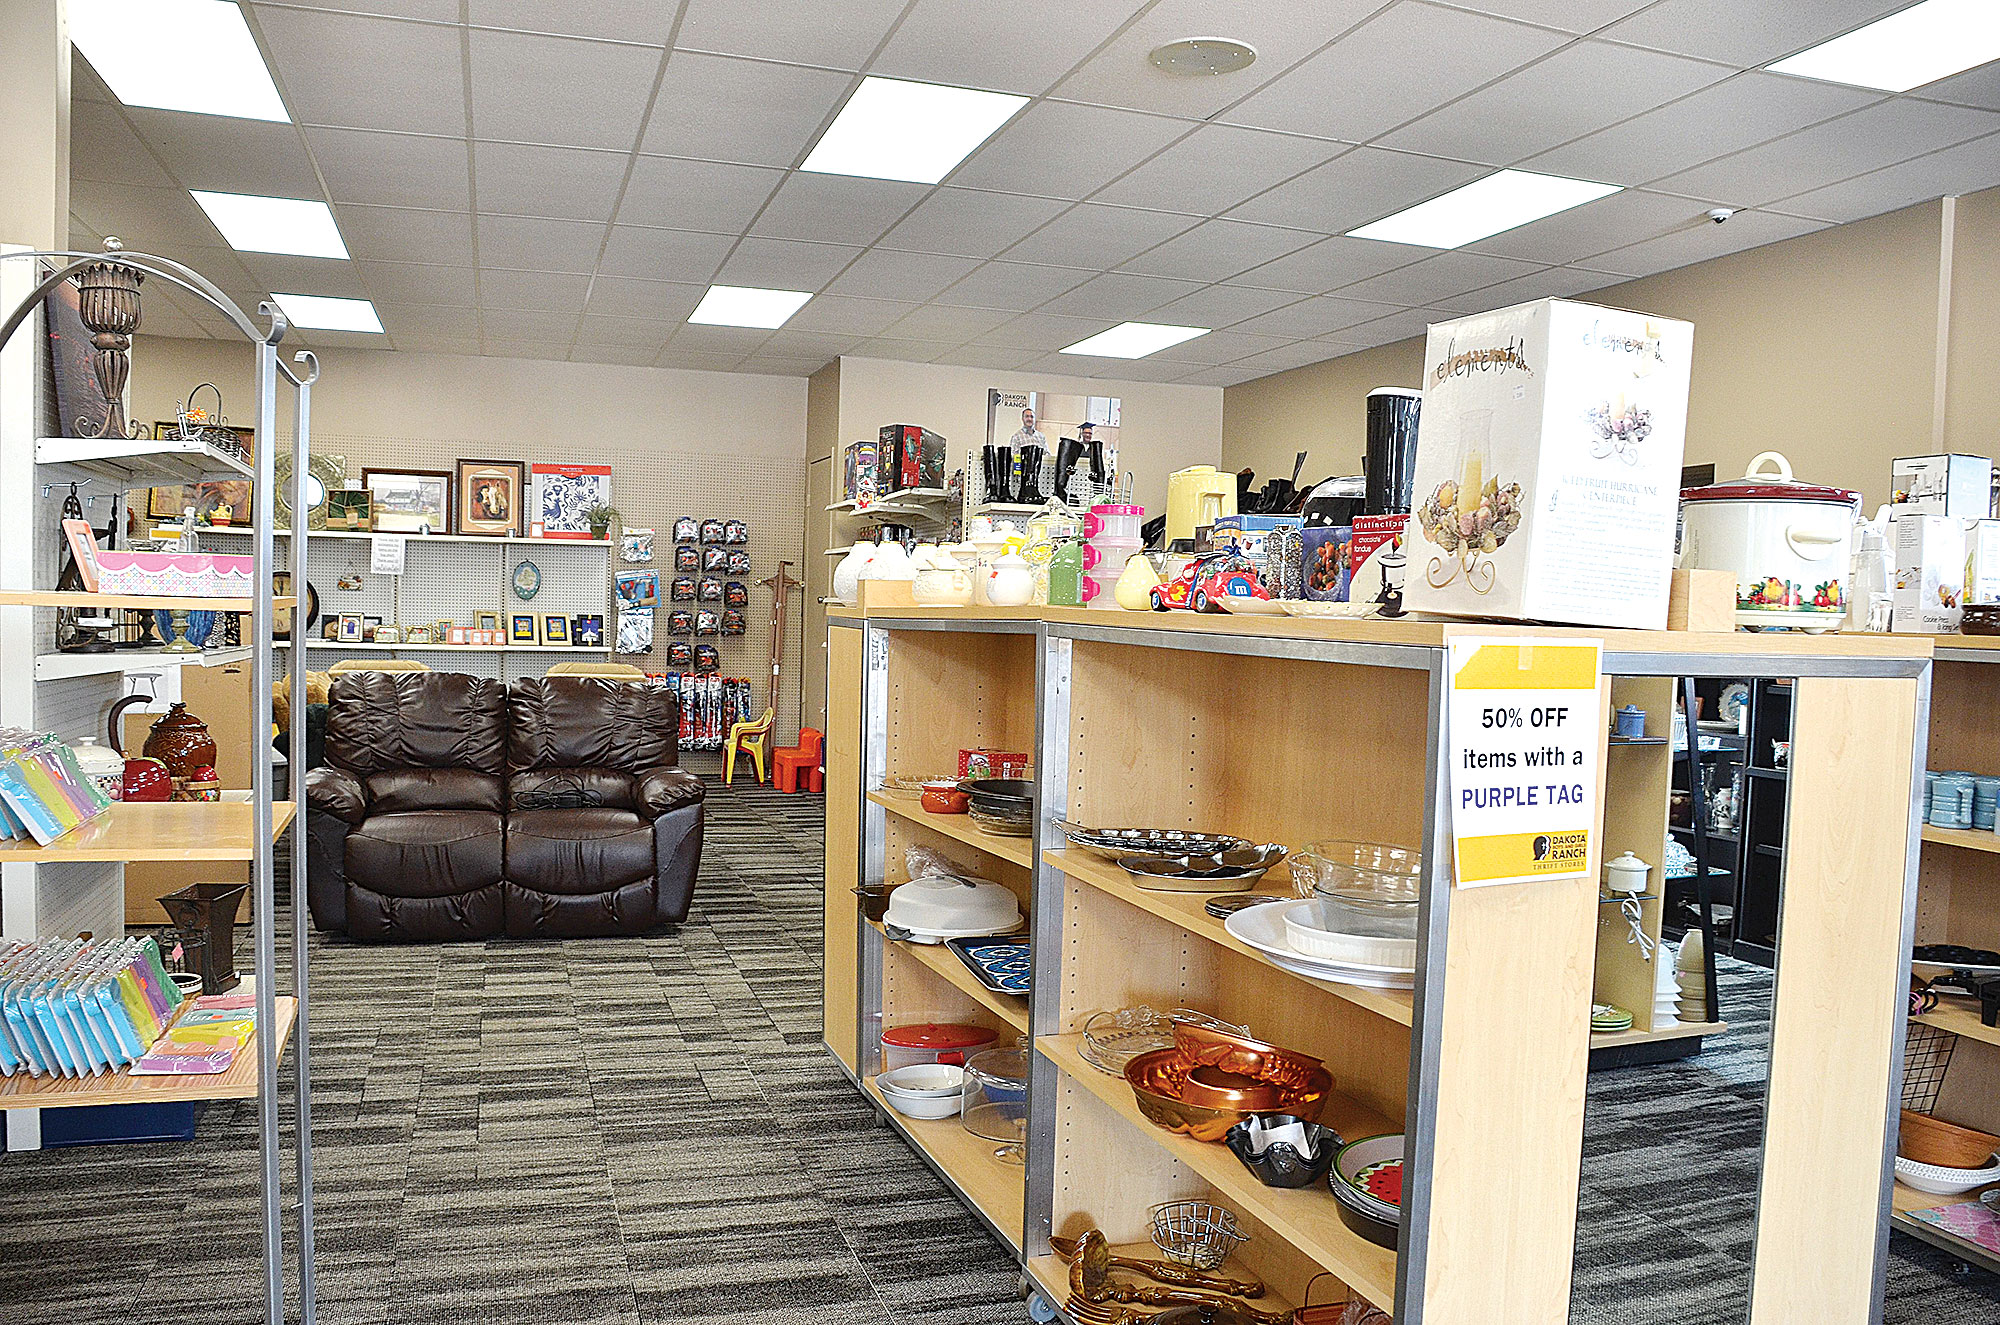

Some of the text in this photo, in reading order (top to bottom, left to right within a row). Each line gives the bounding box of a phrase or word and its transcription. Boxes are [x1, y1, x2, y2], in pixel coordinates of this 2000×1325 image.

[1436, 336, 1534, 384] elements
[1234, 585, 1248, 595] m
[1481, 707, 1569, 729] 50% OFF
[1463, 746, 1583, 769] items with a
[1462, 784, 1583, 810] PURPLE TAG
[1552, 834, 1586, 845] DAKOTA
[1552, 848, 1586, 860] RANCH
[1533, 860, 1585, 870] THRIFT STORES
